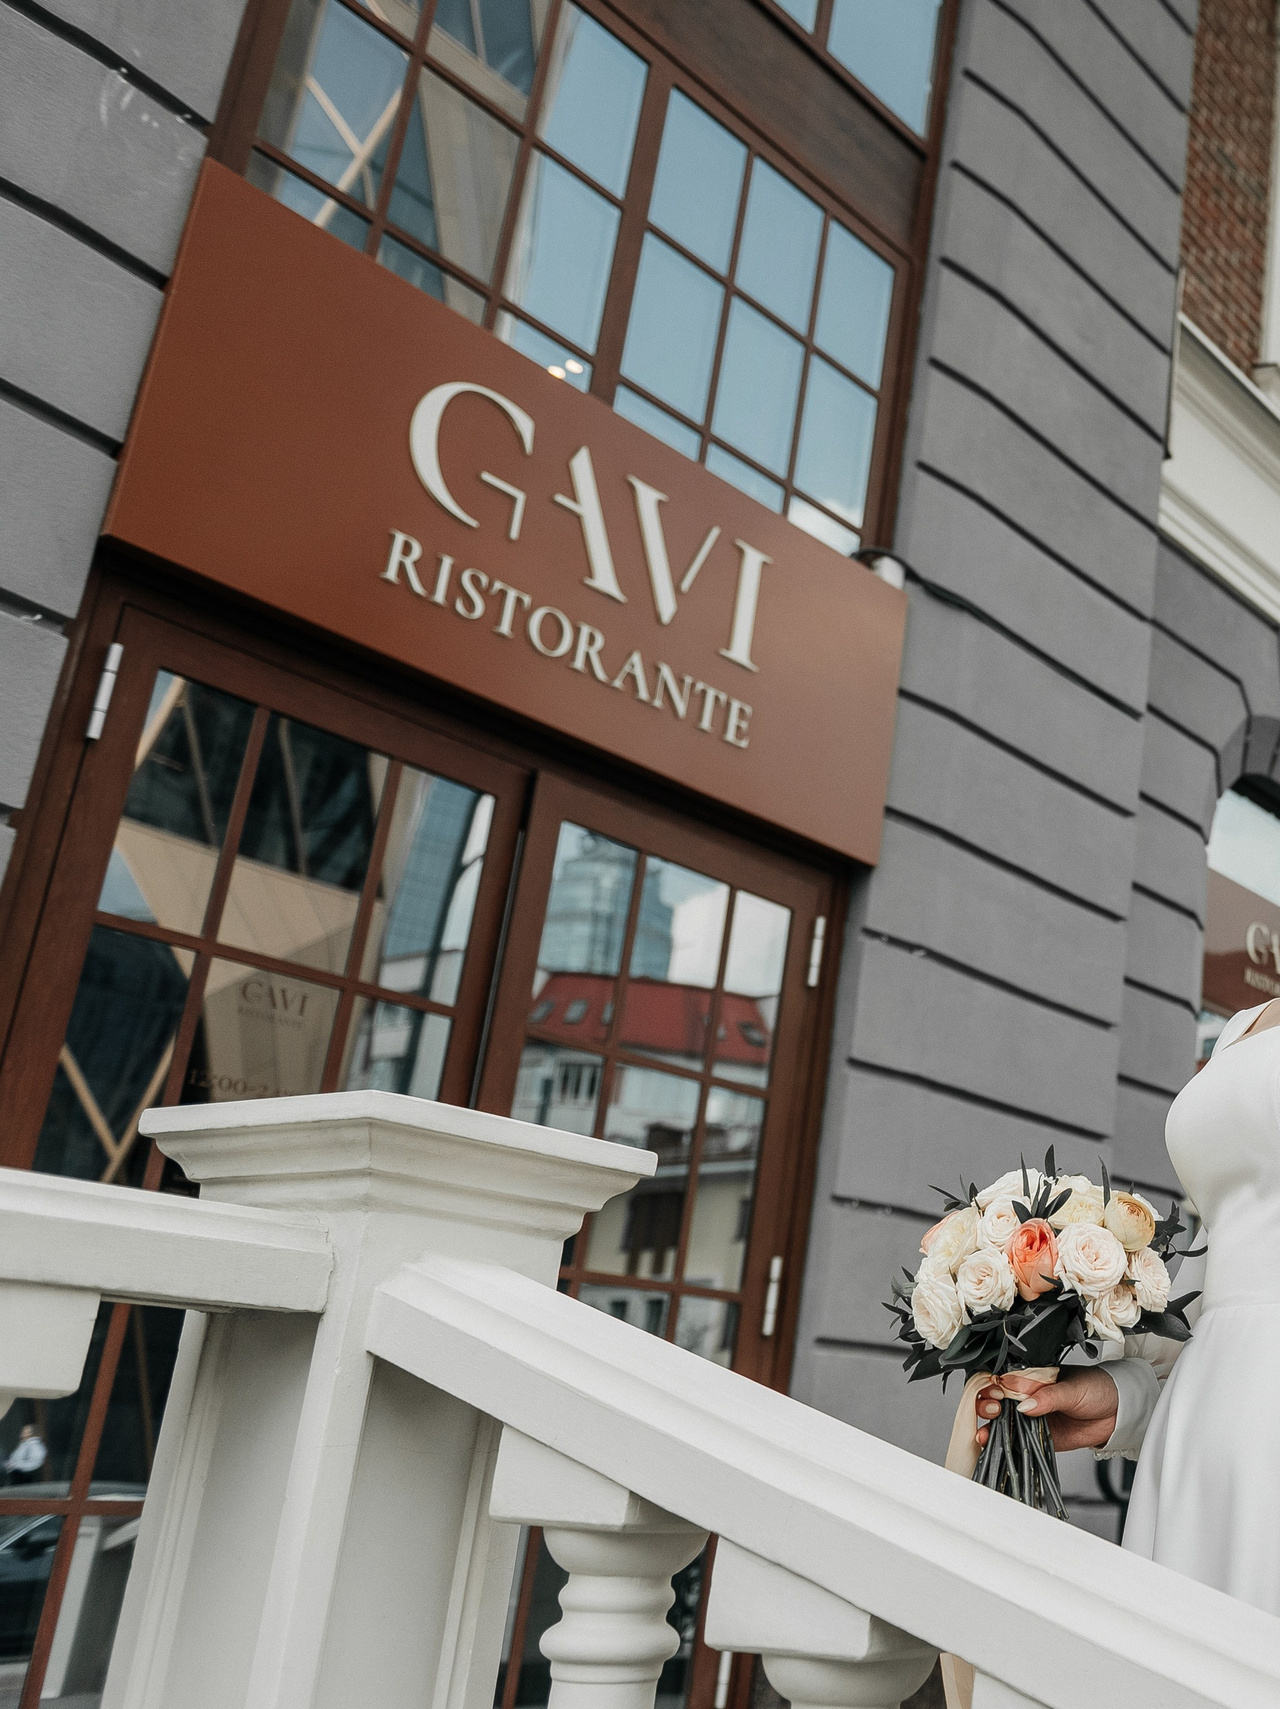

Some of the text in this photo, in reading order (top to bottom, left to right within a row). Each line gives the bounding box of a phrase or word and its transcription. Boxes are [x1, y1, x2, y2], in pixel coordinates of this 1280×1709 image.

[409, 381, 774, 673] GAVI
[380, 528, 753, 749] RISTORANTE
[241, 980, 309, 1017] GAVI
